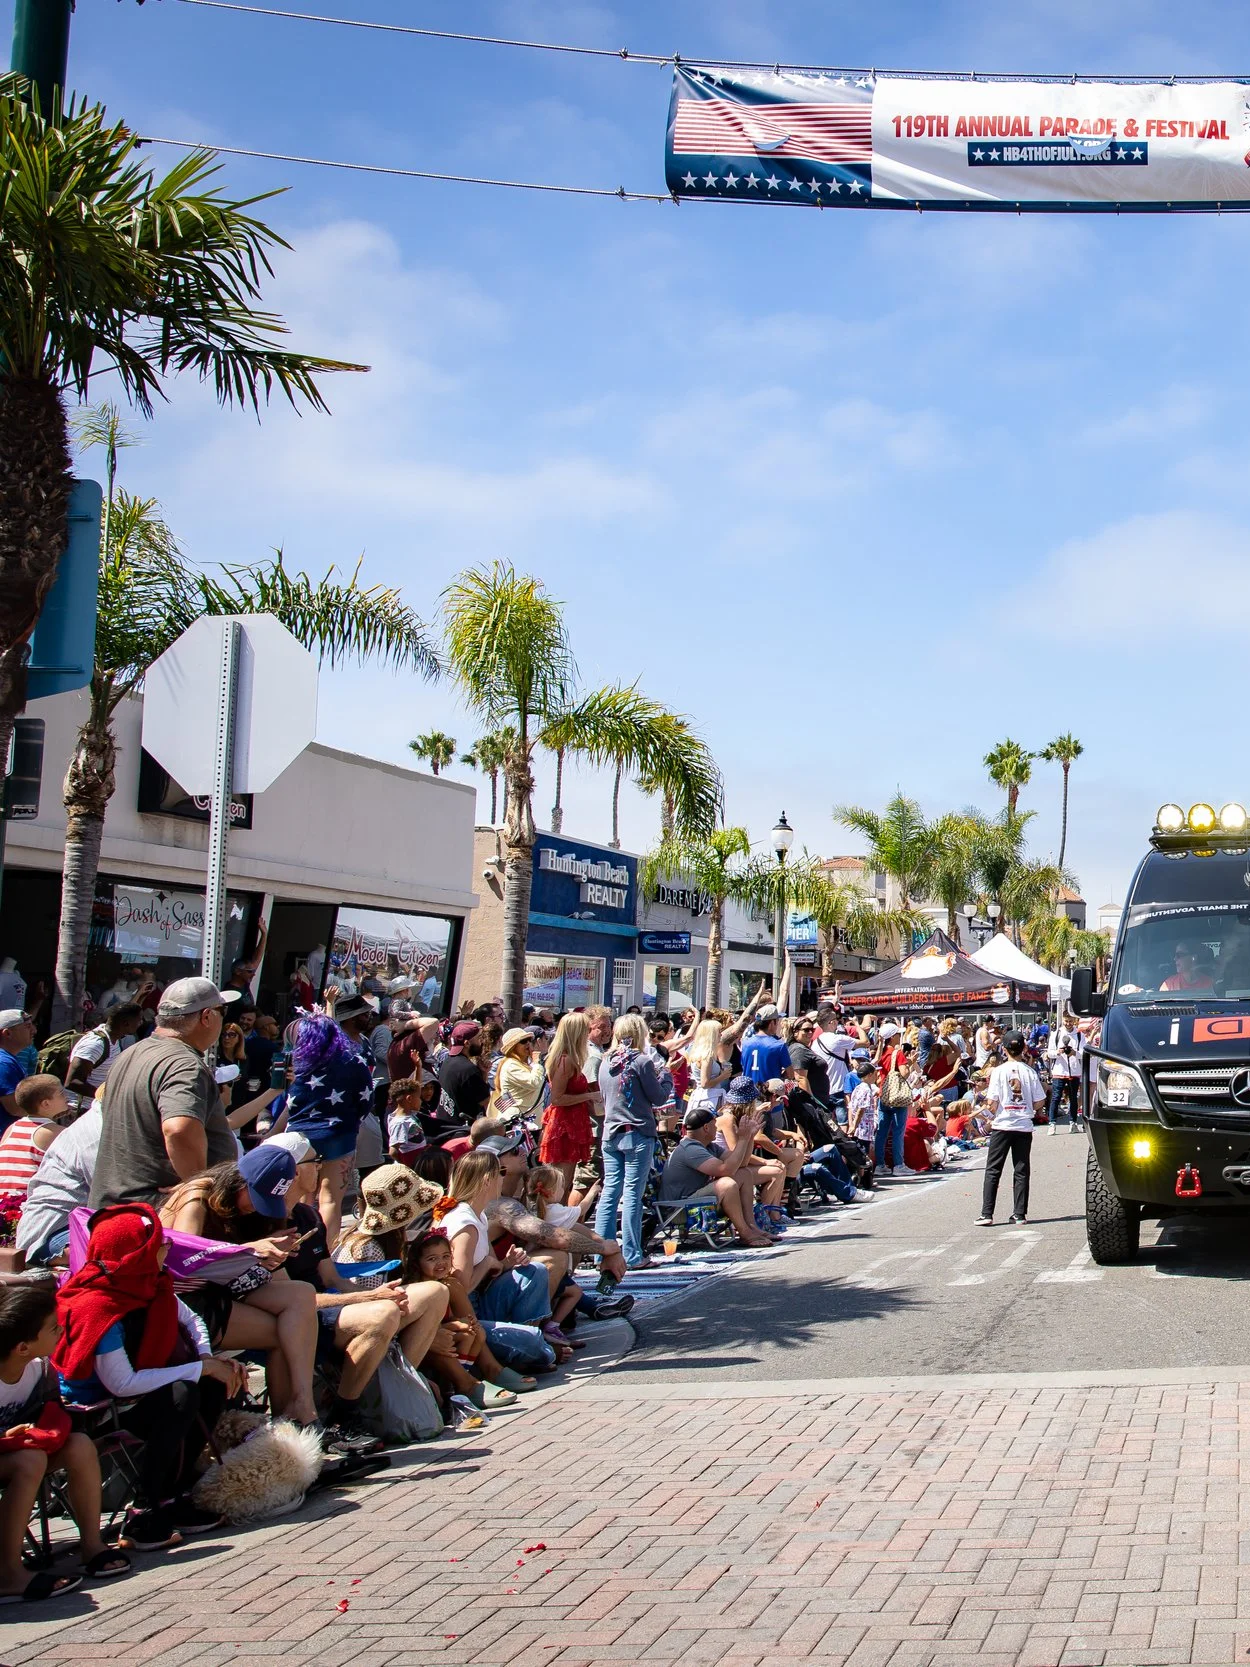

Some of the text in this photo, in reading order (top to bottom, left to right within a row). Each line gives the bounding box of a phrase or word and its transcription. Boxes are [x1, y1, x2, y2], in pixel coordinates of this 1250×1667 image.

[892, 115, 1230, 140] 119TH ANNUAL PARADE & FESTIVAL
[540, 848, 629, 886] Huntington Beach
[584, 883, 628, 909] REALTY
[659, 884, 684, 906] DARE
[684, 891, 697, 910] ME
[115, 896, 161, 927] Dash
[172, 901, 205, 927] Sass
[786, 928, 810, 940] PIER
[341, 928, 440, 972] Model Citizen
[842, 992, 988, 1006] SURFBOARD BUILDERS HALL OF FAME
[894, 985, 937, 994] INTERNATIONAL
[751, 1049, 760, 1071] 1
[1112, 1092, 1125, 1103] 32
